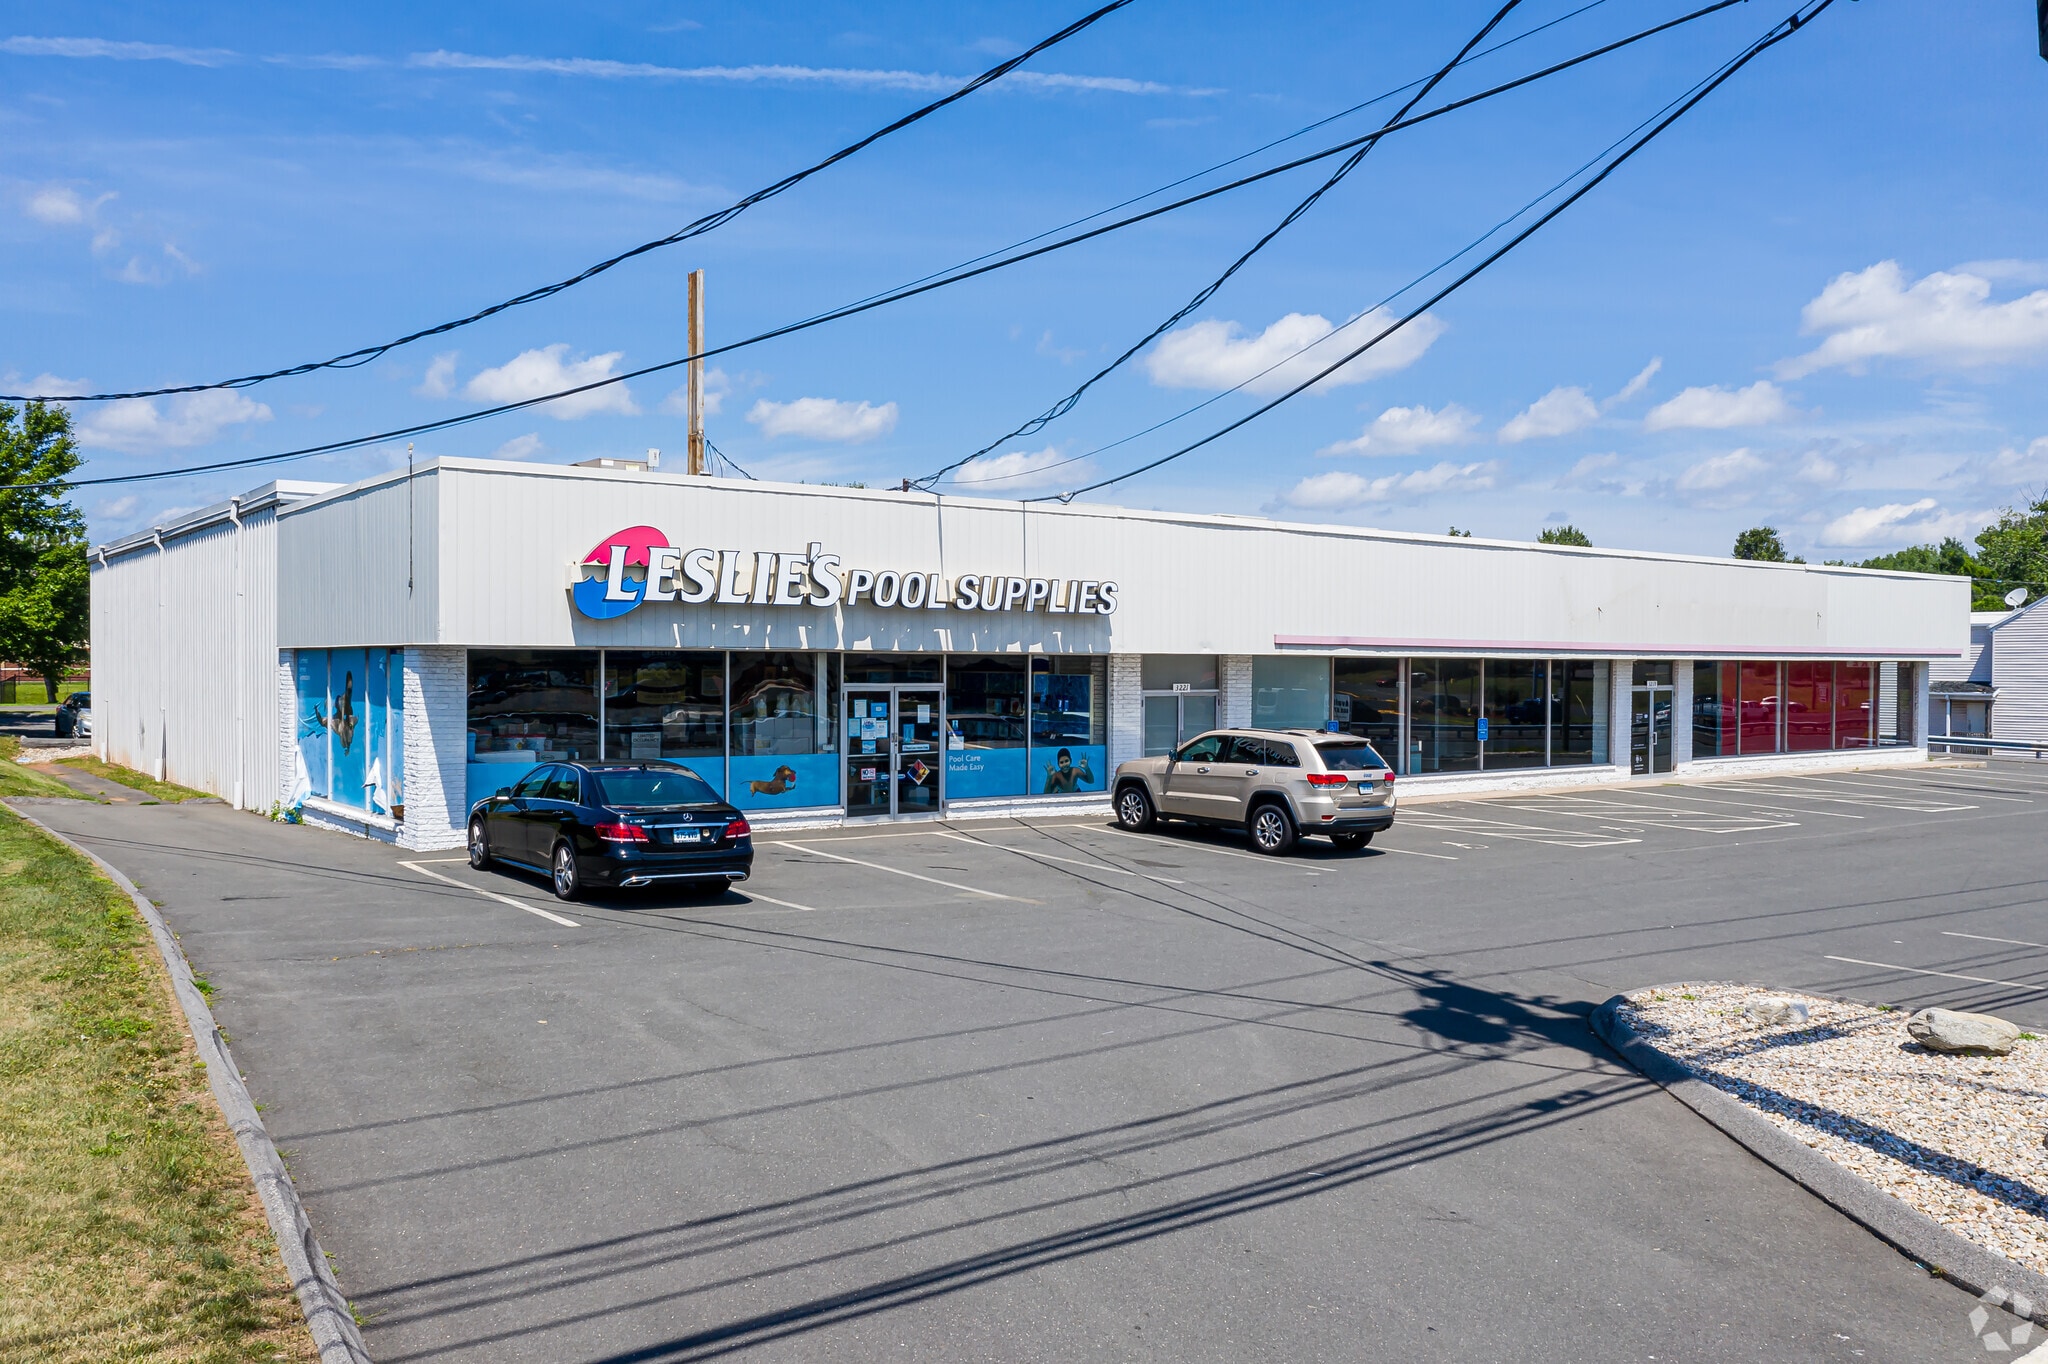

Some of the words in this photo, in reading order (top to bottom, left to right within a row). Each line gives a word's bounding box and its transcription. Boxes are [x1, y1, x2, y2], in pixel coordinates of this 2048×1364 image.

[603, 542, 843, 608] LESLIE'S
[847, 569, 947, 610] POOL
[952, 573, 1119, 616] SUPPLIES
[948, 754, 964, 763] Pool
[965, 754, 981, 762] Care
[948, 763, 968, 772] Made
[969, 763, 985, 772] Easy
